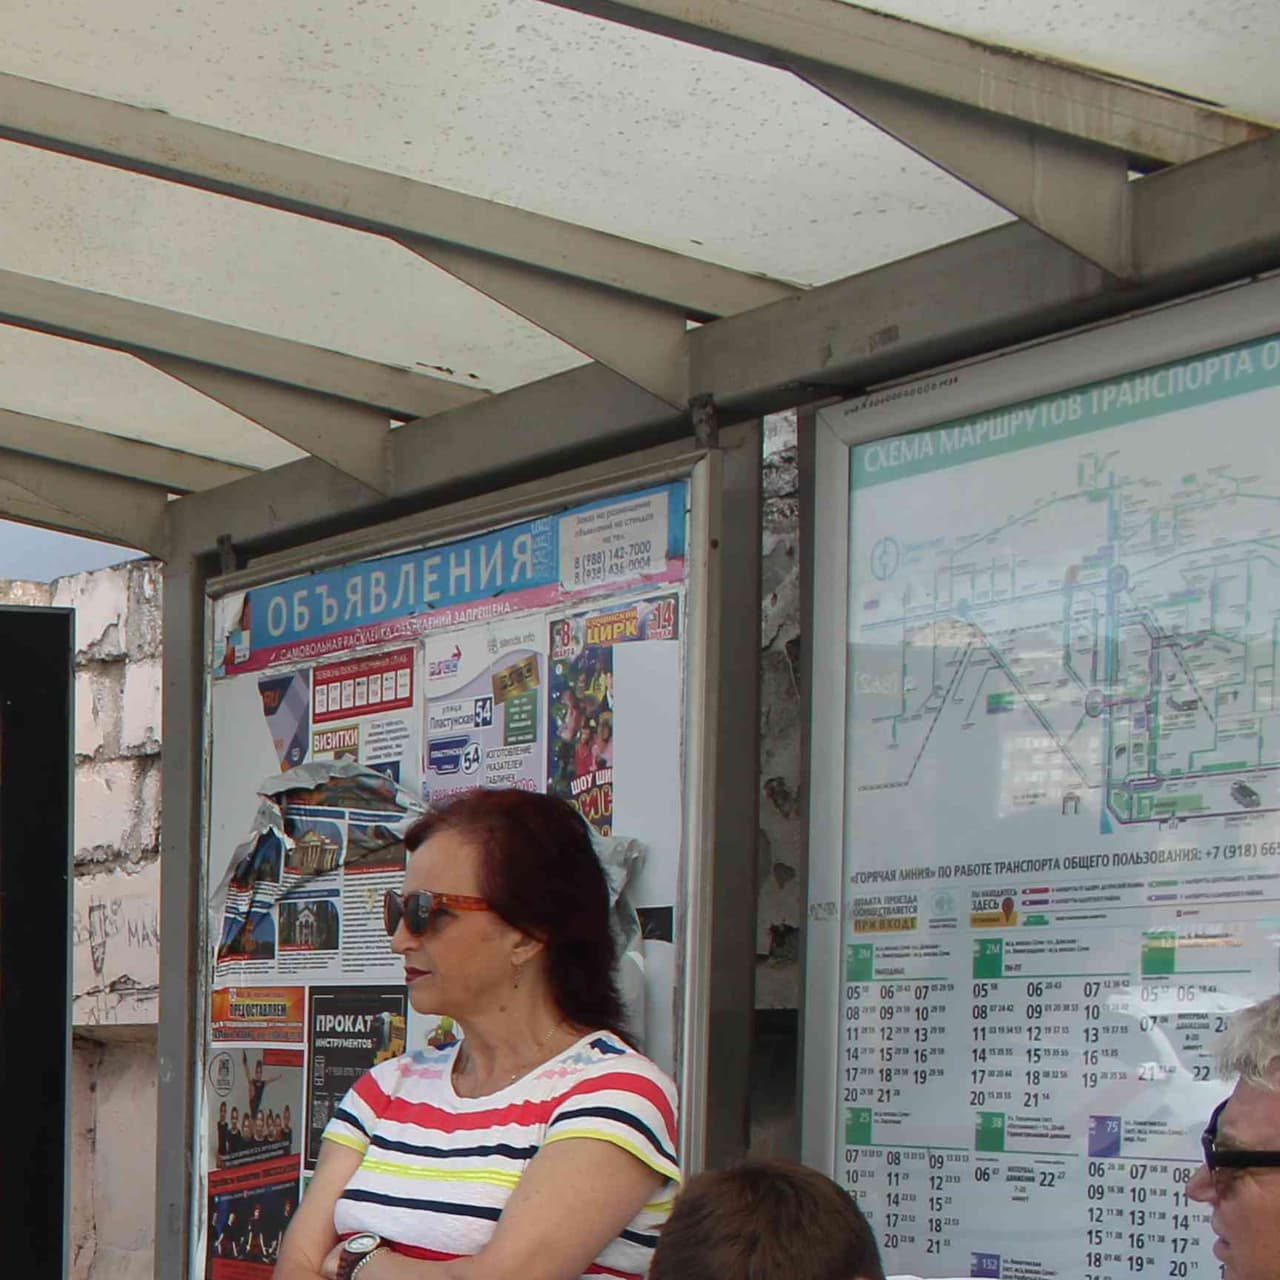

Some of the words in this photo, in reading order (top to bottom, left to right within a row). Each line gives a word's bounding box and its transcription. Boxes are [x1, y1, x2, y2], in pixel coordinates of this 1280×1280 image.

[865, 439, 934, 472] СХЕМА
[940, 399, 1082, 453] МАРШРУТОВ
[1090, 348, 1253, 416] ТРАНСПОРТА
[267, 534, 534, 637] ОБЪЯВЛЕНИЯ
[454, 601, 511, 623] ЗАПРЕЩЕНА
[561, 620, 570, 647] 8
[587, 620, 638, 644] ЦИРК
[475, 700, 491, 722] 54
[314, 729, 358, 751] ВИЗИТКИ
[464, 747, 480, 770] 54
[571, 771, 593, 795] ШОУ
[851, 870, 896, 884] «ГОРЯЧАЯ
[899, 867, 936, 880] ЛИНИЯ»
[938, 865, 952, 878] ПО
[954, 863, 991, 877] РАБОТЕ
[994, 857, 1060, 874] ТРАНСПОРТА
[1063, 853, 1110, 870] ОБЩЕГО
[1112, 848, 1201, 866] ПОЛЬЗОВАНИЯ:
[1205, 846, 1221, 859] +7
[1223, 842, 1257, 860] (918)
[970, 899, 1000, 911] ЗДЕСЬ
[847, 986, 860, 1000] 05
[880, 985, 894, 999] 06
[915, 985, 929, 1000] 07
[973, 983, 988, 998] 05
[1027, 982, 1043, 997] 06
[1083, 982, 1101, 997] 07
[847, 1006, 860, 1020] 08
[880, 1006, 893, 1020] 09
[916, 1007, 928, 1021] 10
[973, 1005, 987, 1019] 08
[1027, 1004, 1042, 1019] 09
[1085, 1005, 1100, 1020] 10
[316, 1015, 373, 1032] ПРОКАТ
[316, 1038, 372, 1048] ИНСТРУМЕНТОВ
[847, 1028, 858, 1040] 11
[881, 1027, 893, 1041] 12
[914, 1028, 928, 1042] 13
[972, 1027, 986, 1041] 11
[1027, 1026, 1041, 1041] 12
[1083, 1028, 1099, 1043] 13
[846, 1048, 858, 1061] 14
[880, 1048, 892, 1061] 15
[914, 1049, 927, 1063] 16
[972, 1048, 987, 1063] 14
[1026, 1048, 1040, 1063] 15
[1083, 1050, 1098, 1065] 16
[846, 1068, 858, 1081] 17
[880, 1068, 892, 1082] 18
[914, 1070, 926, 1084] 19
[971, 1069, 986, 1084] 17
[1026, 1071, 1040, 1085] 18
[1082, 1073, 1097, 1088] 19
[844, 1088, 858, 1101] 20
[878, 1089, 890, 1102] 21
[970, 1091, 985, 1106] 20
[1024, 1093, 1039, 1107] 21
[1106, 1121, 1118, 1132] 75
[845, 1150, 859, 1163] 07
[887, 1151, 901, 1165] 08
[929, 1154, 944, 1169] 09
[846, 1170, 858, 1183] 10
[887, 1173, 899, 1186] 11
[929, 1176, 943, 1190] 12
[975, 1167, 990, 1182] 06
[1039, 1171, 1055, 1187] 22
[1088, 1162, 1105, 1177] 06
[1130, 1164, 1148, 1179] 07
[1173, 1168, 1190, 1183] 08
[887, 1192, 899, 1207] 14
[929, 1197, 942, 1212] 15
[1088, 1185, 1104, 1200] 09
[1130, 1188, 1146, 1203] 10
[1173, 1192, 1188, 1207] 11
[886, 1214, 898, 1228] 17
[928, 1218, 942, 1232] 18
[1088, 1208, 1103, 1223] 12
[1129, 1210, 1145, 1226] 13
[1172, 1215, 1189, 1230] 14
[884, 1234, 898, 1248] 20
[926, 1239, 940, 1253] 21
[1087, 1230, 1102, 1245] 15
[1128, 1233, 1145, 1249] 16
[1171, 1238, 1188, 1254] 17
[1086, 1252, 1101, 1268] 18
[1127, 1256, 1144, 1272] 19
[1169, 1261, 1187, 1277] 20
